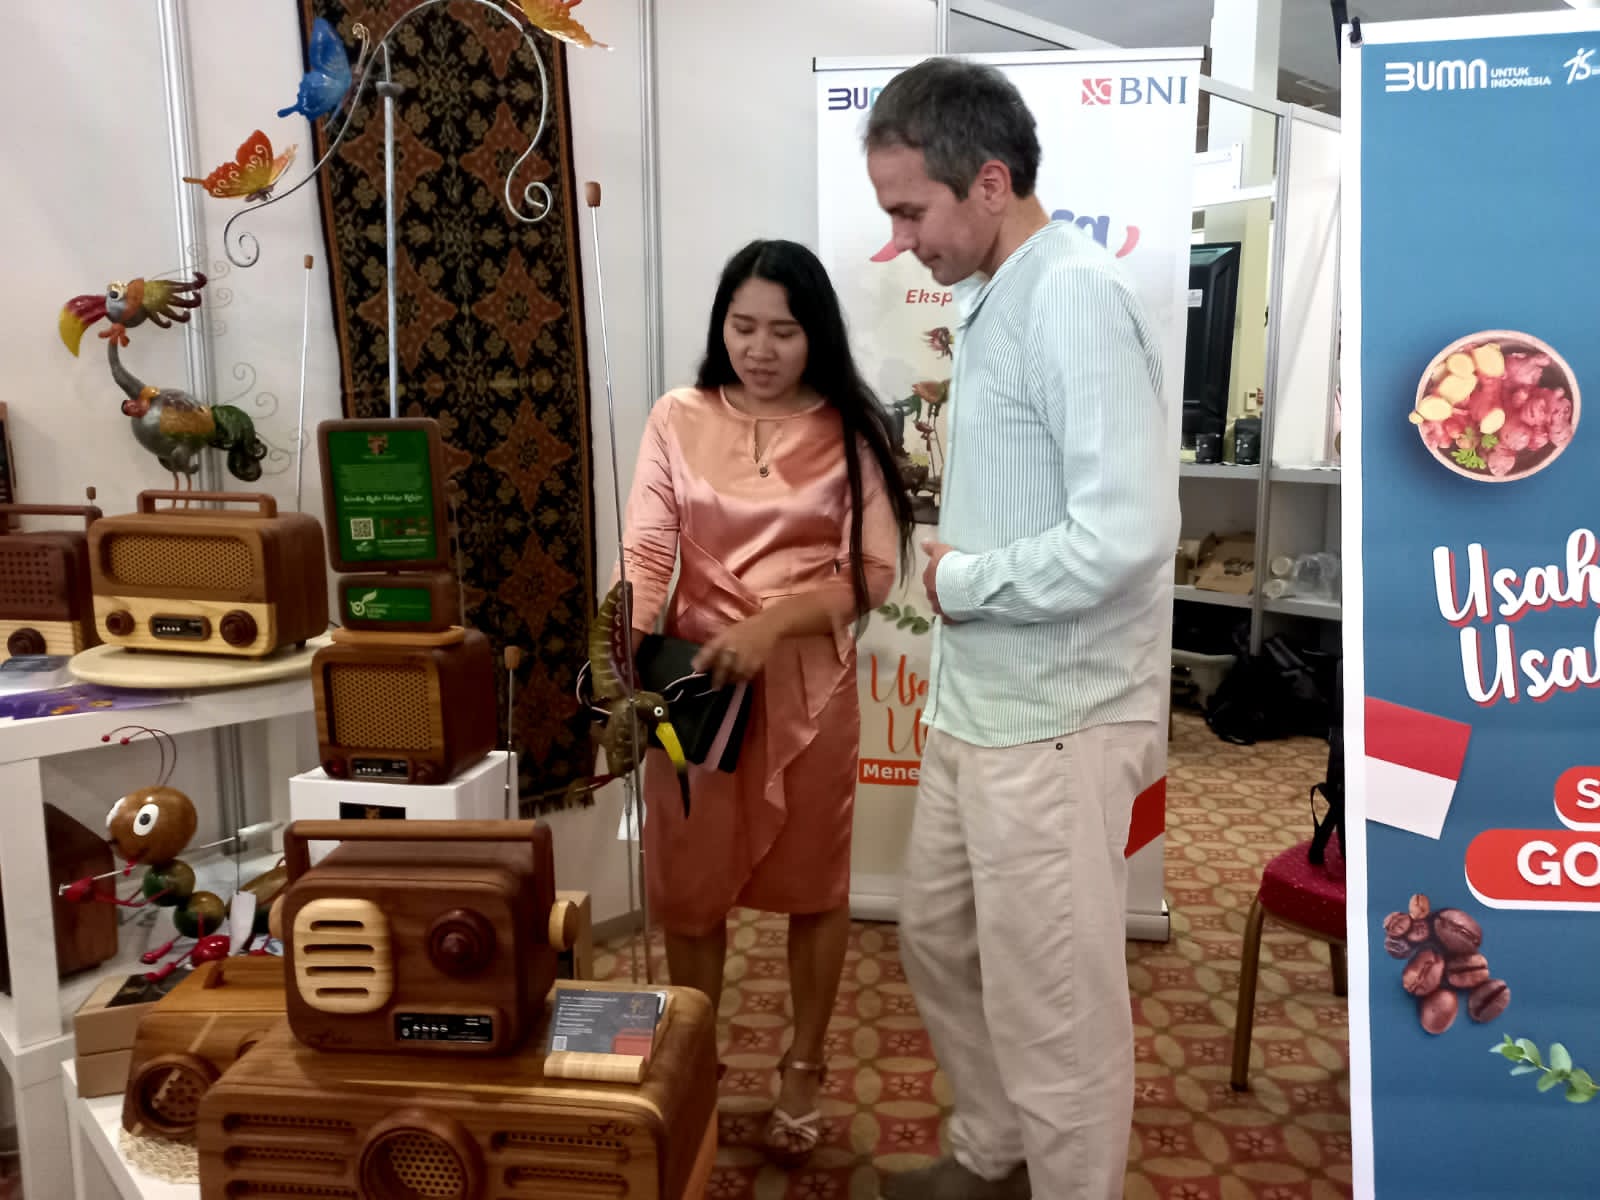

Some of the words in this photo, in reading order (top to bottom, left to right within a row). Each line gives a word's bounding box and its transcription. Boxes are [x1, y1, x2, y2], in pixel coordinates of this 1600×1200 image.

[1490, 67, 1529, 78] UNTUK
[1119, 76, 1188, 105] BNI
[1490, 76, 1552, 88] INDONESIA
[905, 289, 953, 307] Eksp
[1432, 528, 1600, 625] Usah
[863, 763, 921, 780] Mene
[1516, 840, 1600, 888] GO
